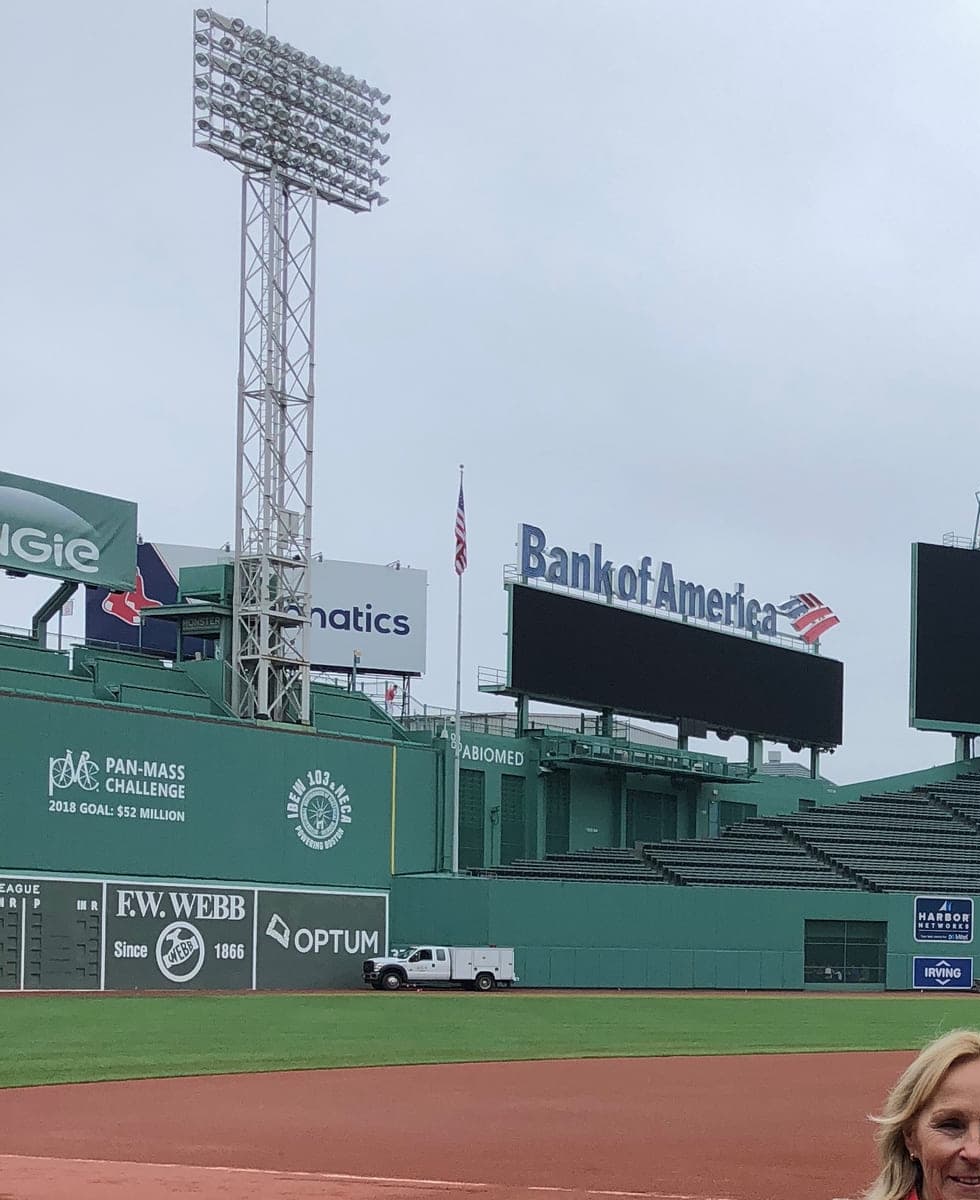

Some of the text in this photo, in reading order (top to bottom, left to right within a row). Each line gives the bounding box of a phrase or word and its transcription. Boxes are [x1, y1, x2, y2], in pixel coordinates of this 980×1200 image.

[518, 523, 777, 636] Bank of America
[284, 603, 411, 636] natics
[462, 744, 525, 766] ABIOMED
[105, 757, 186, 781] PAN-MASS
[105, 778, 186, 799] CHALLENGE
[307, 769, 330, 786] 103
[335, 784, 352, 823] NECA
[48, 800, 186, 822] 2018 GOAL: $52 MILLION
[33, 899, 41, 909] P
[91, 901, 98, 911] R
[116, 890, 246, 920] F.W. WEBB
[918, 912, 969, 922] HARBOR
[918, 922, 970, 930] NETWORKS
[114, 941, 245, 959] Since 1866
[168, 940, 195, 964] WEBB
[294, 928, 379, 954] OPTUM
[924, 967, 961, 978] IRVING
